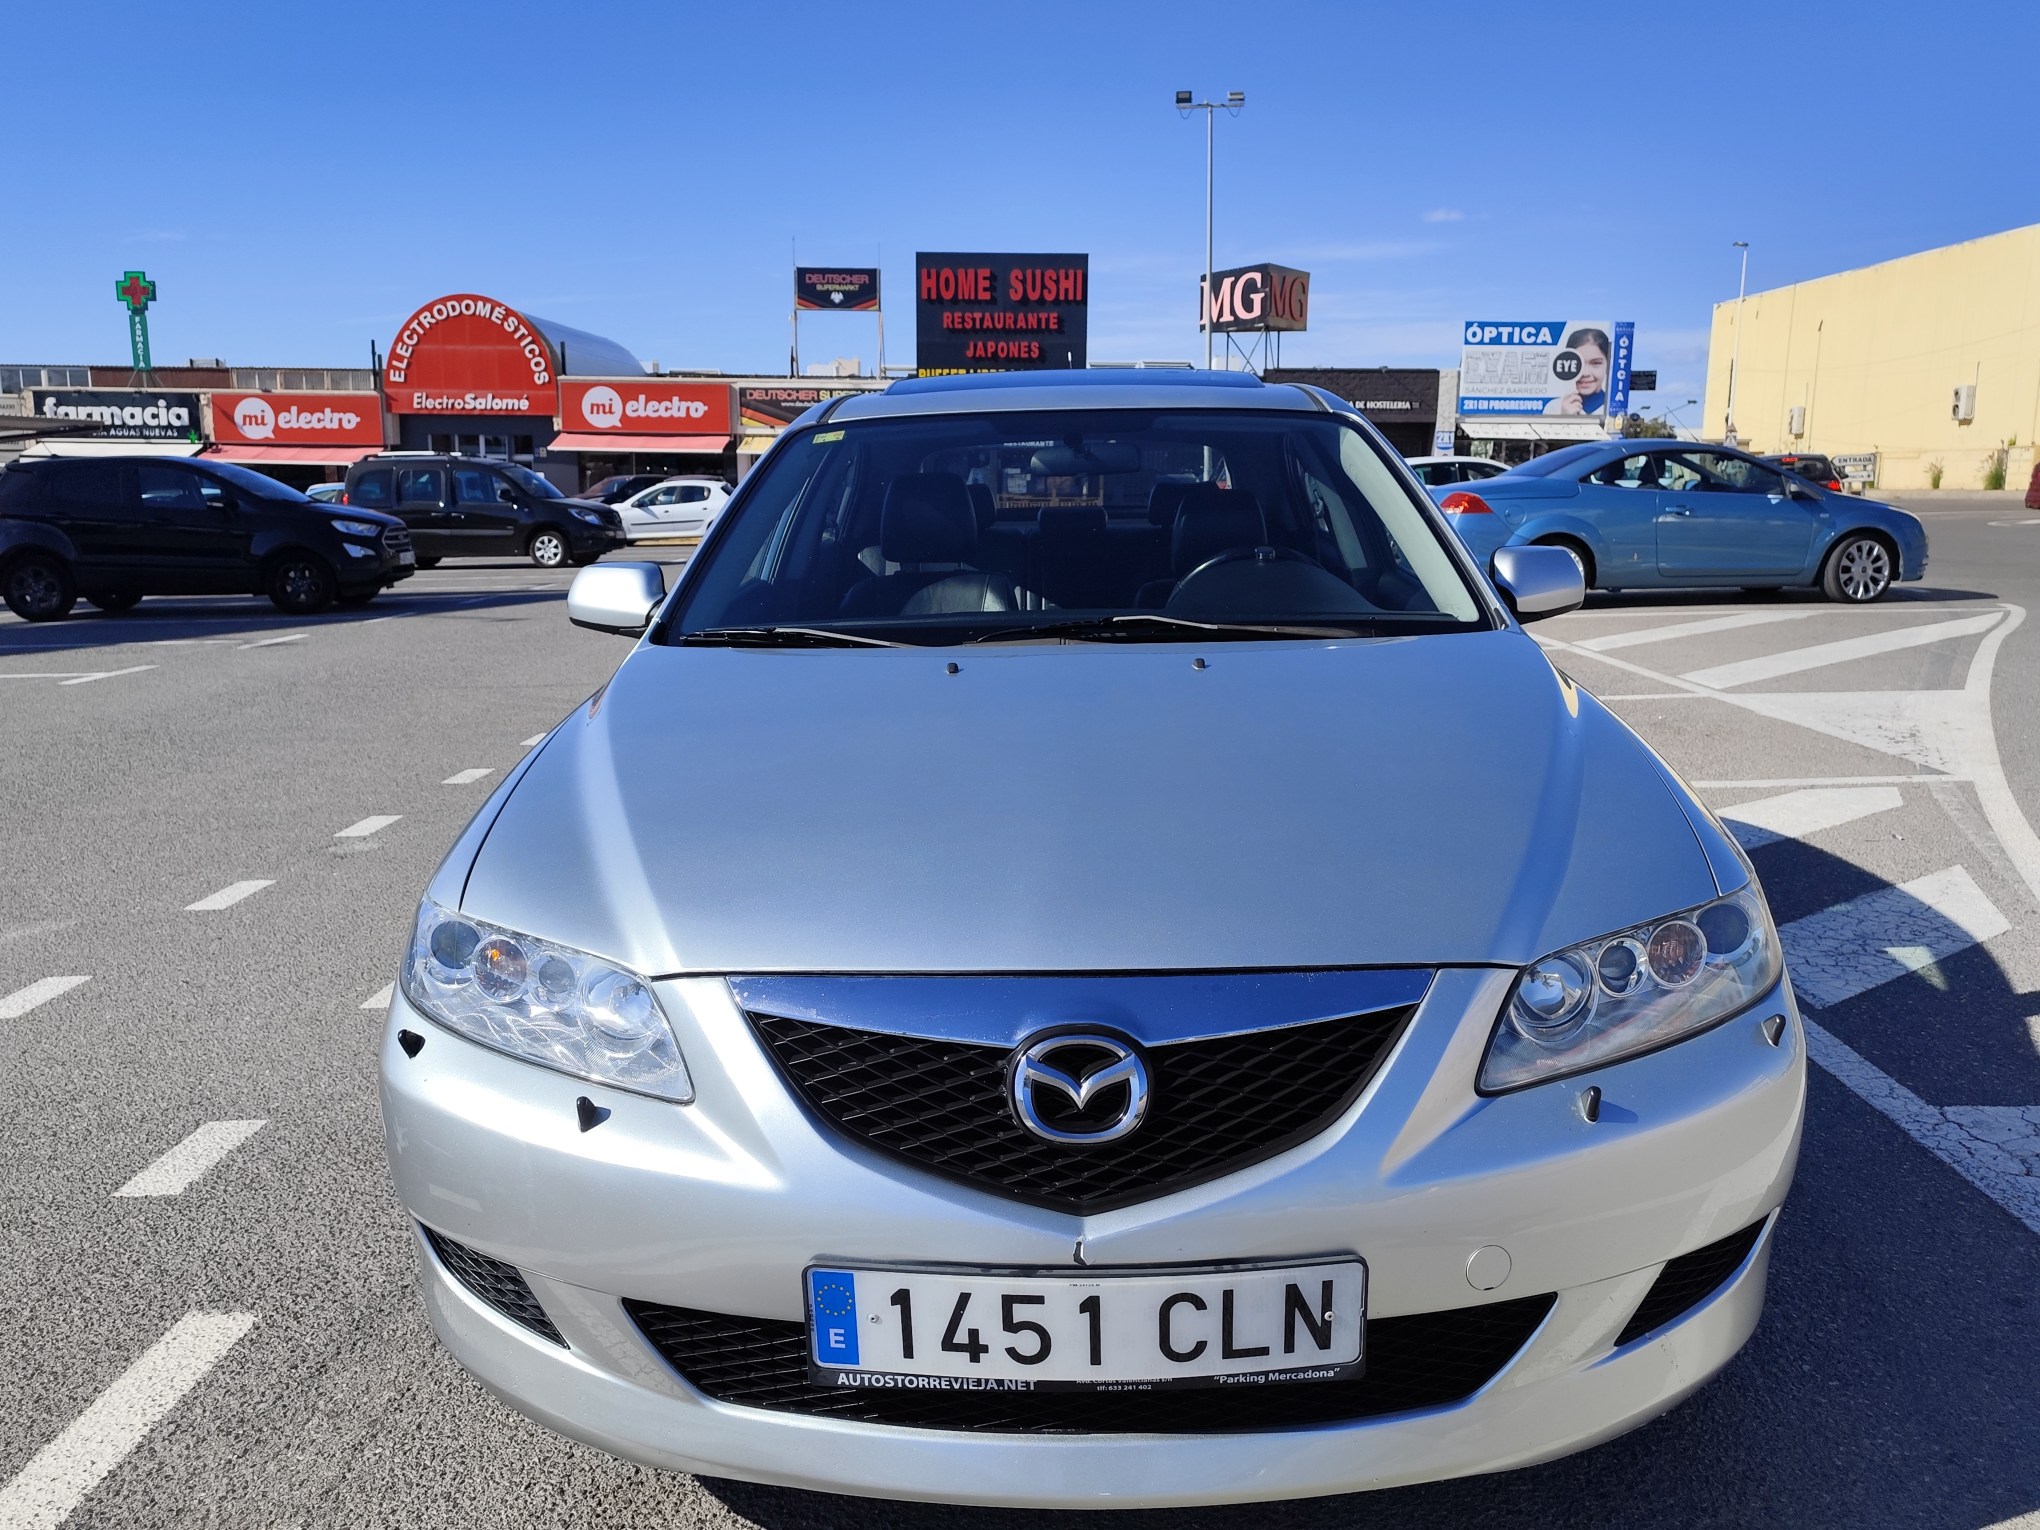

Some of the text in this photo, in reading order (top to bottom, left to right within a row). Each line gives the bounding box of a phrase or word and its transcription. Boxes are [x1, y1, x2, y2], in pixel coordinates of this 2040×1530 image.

[805, 274, 869, 284] DEUTSCHER
[921, 268, 1083, 301] HOME SUSHI
[1200, 272, 1265, 324] MG
[1271, 273, 1306, 321] MG
[943, 312, 1058, 329] RESTAURANTE
[135, 316, 145, 368] FARMACIA
[390, 299, 549, 384] ELECTRODOMÉSTICOS
[1466, 323, 1552, 344] ÓPTICA
[965, 341, 1039, 358] JAPONES
[1556, 362, 1577, 373] EYE
[746, 389, 817, 400] DEUTSCHER
[43, 396, 190, 427] farmacia
[590, 395, 708, 419] mi electro
[1355, 401, 1365, 409] DE
[1463, 400, 1543, 410] 2X1 EN PROGRESIVOS
[242, 405, 360, 430] mi electro
[110, 427, 141, 437] AGUAS
[144, 427, 178, 437] NUEVAS
[1437, 432, 1454, 443] 2X1
[890, 1280, 1333, 1366] 1451 CLN
[829, 1328, 846, 1348] E
[837, 1373, 1037, 1391] AUTOSTORREVIEJA.NET
